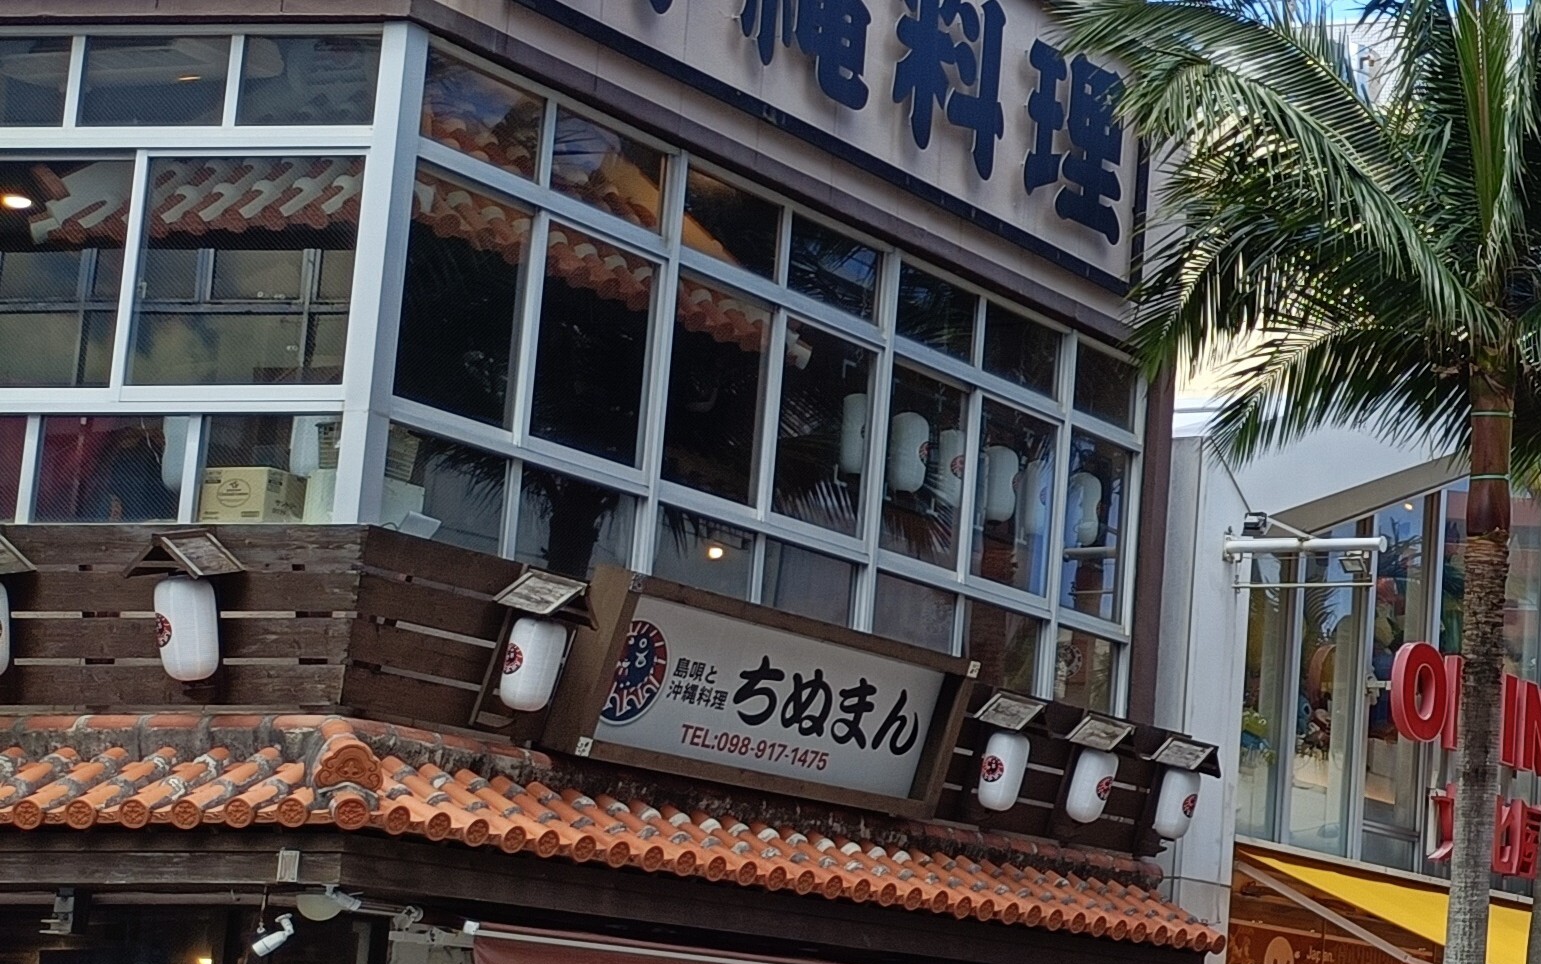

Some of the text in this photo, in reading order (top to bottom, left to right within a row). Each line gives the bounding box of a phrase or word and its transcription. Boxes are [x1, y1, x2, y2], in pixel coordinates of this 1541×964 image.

[650, 0, 1124, 245] 縄料理
[672, 657, 718, 684] 島唄と
[665, 680, 730, 712] 沖縄料理
[732, 654, 920, 757] ちぬまん
[680, 723, 830, 771] TEL:098-917-1475
